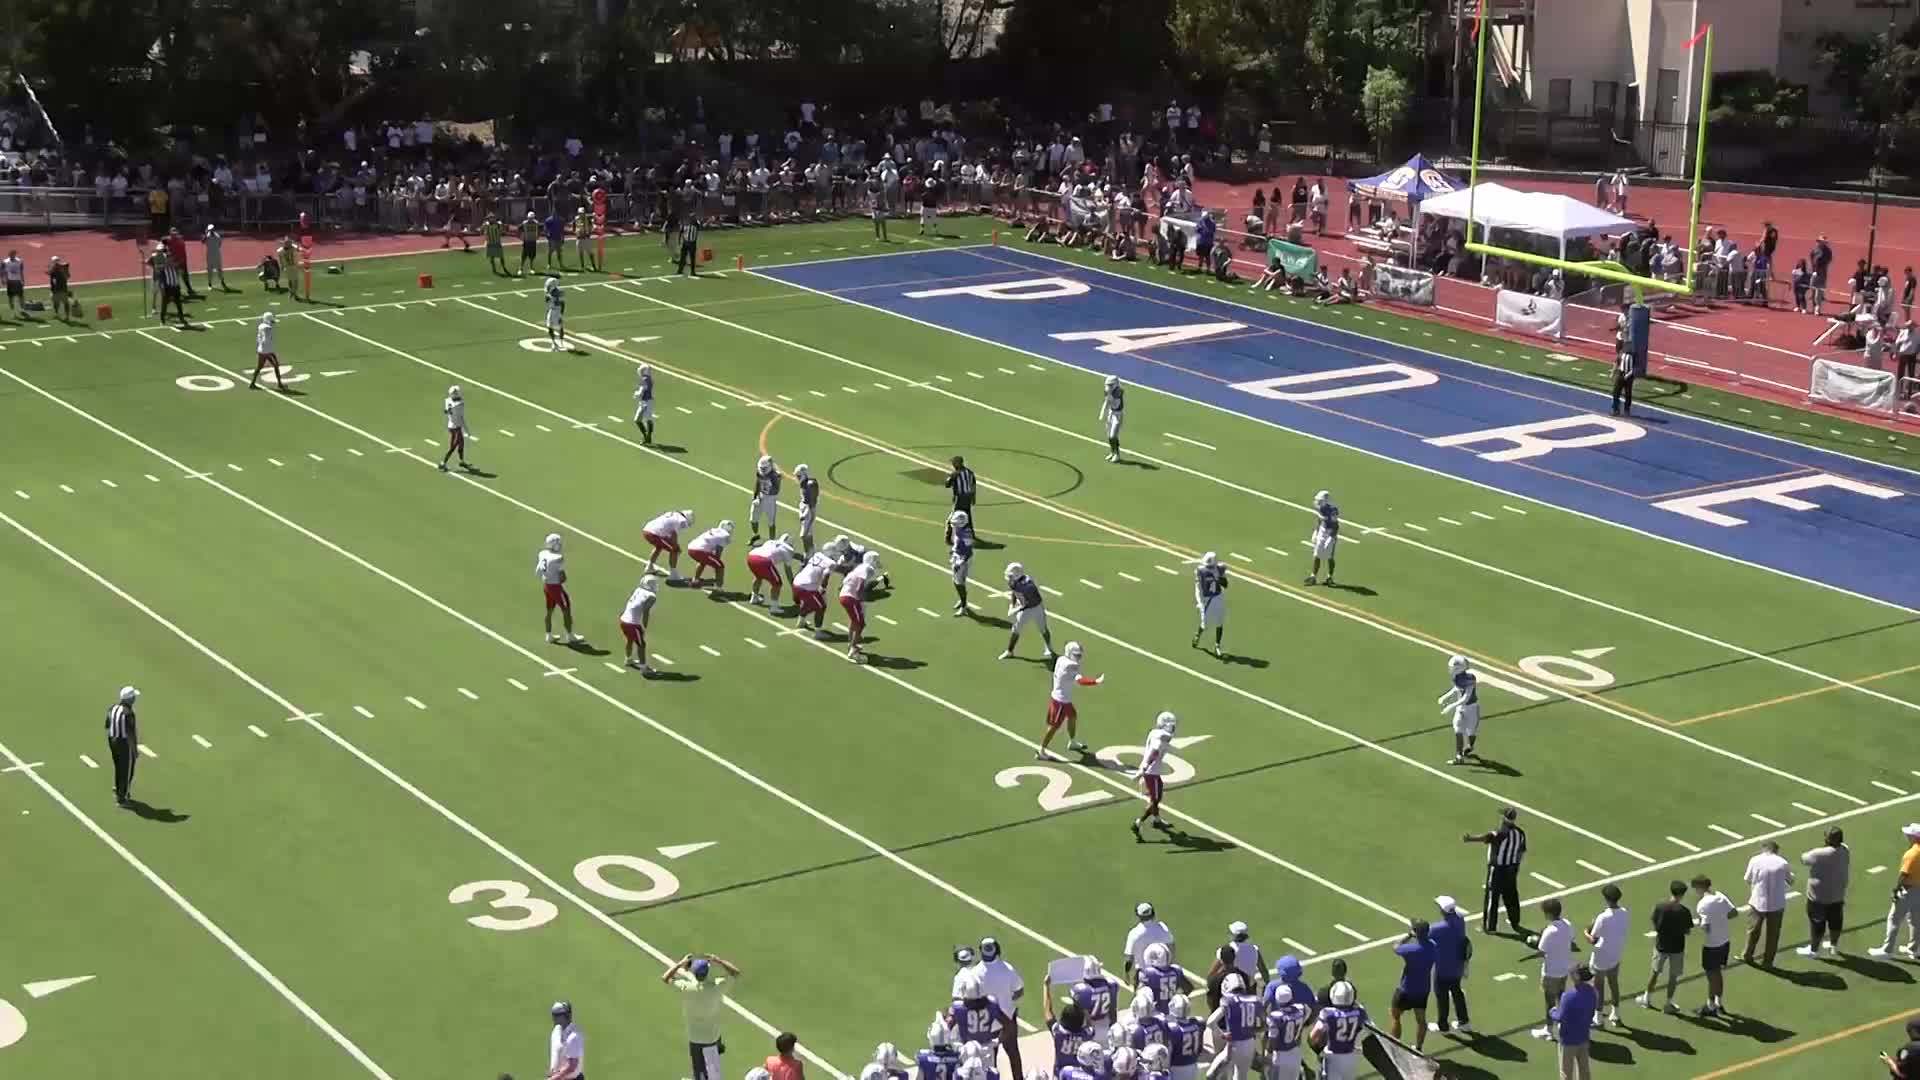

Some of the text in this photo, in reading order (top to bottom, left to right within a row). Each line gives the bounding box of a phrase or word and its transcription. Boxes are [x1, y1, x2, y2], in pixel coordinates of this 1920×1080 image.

[1465, 655, 1616, 701] 10
[994, 744, 1196, 812] 20
[448, 854, 681, 931] 30
[1090, 992, 1111, 1017] 72
[966, 1008, 991, 1033] 92
[1335, 1016, 1360, 1042] 27
[1182, 1031, 1201, 1056] 21
